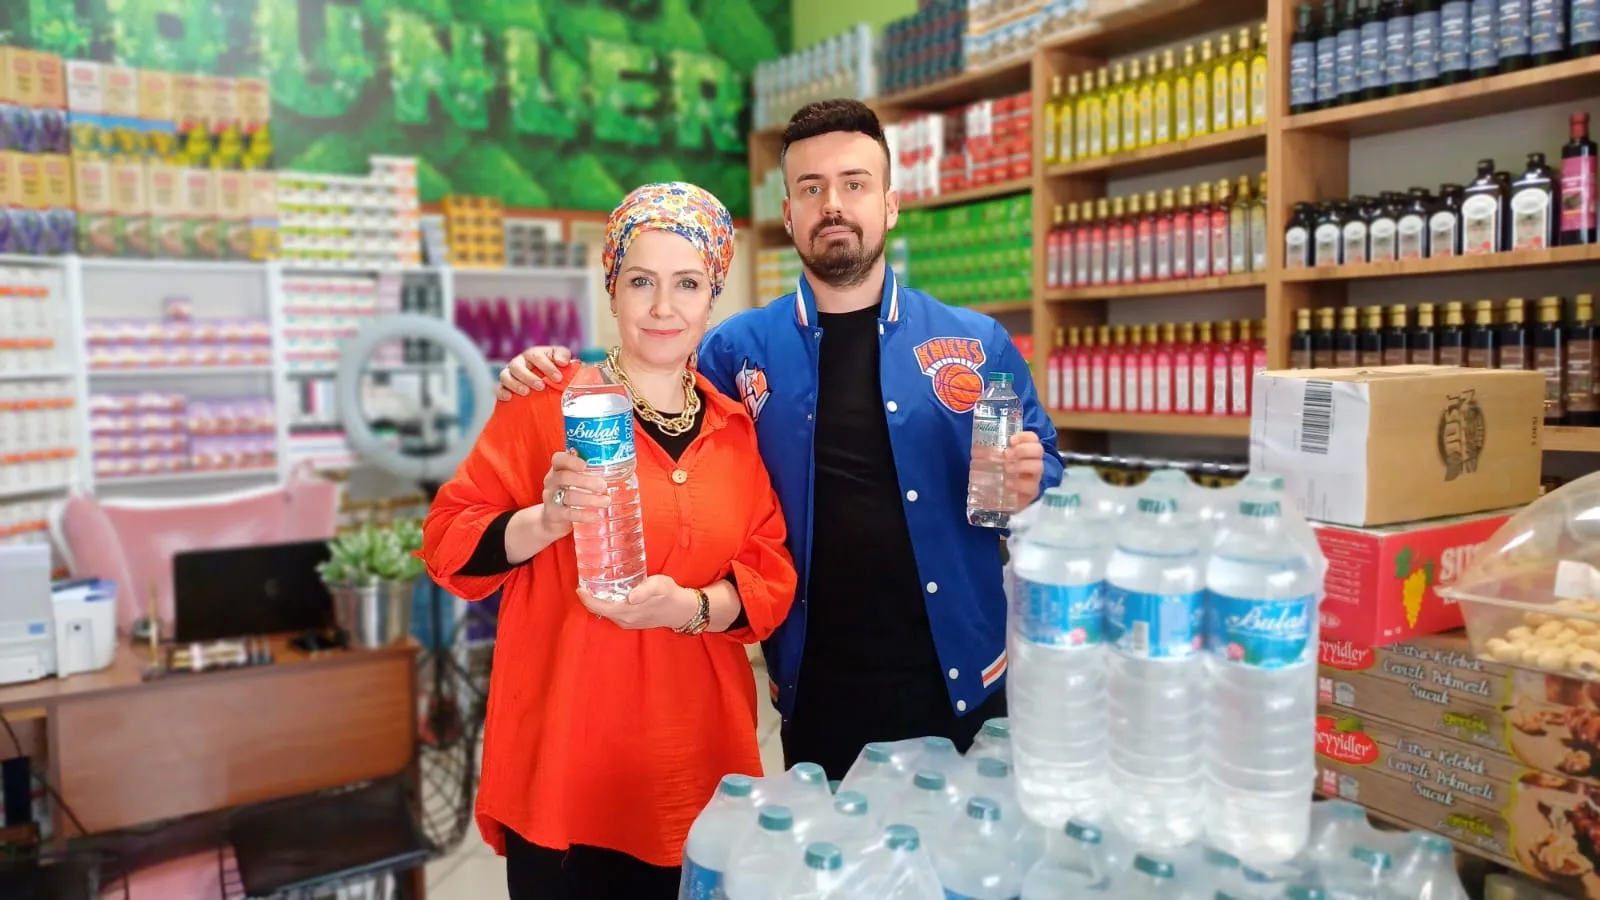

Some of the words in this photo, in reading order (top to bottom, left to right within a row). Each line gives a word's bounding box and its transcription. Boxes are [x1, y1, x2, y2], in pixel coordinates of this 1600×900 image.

[916, 338, 983, 371] KNICKS
[567, 420, 620, 439] Bulak
[1316, 730, 1369, 757] eyyidler
